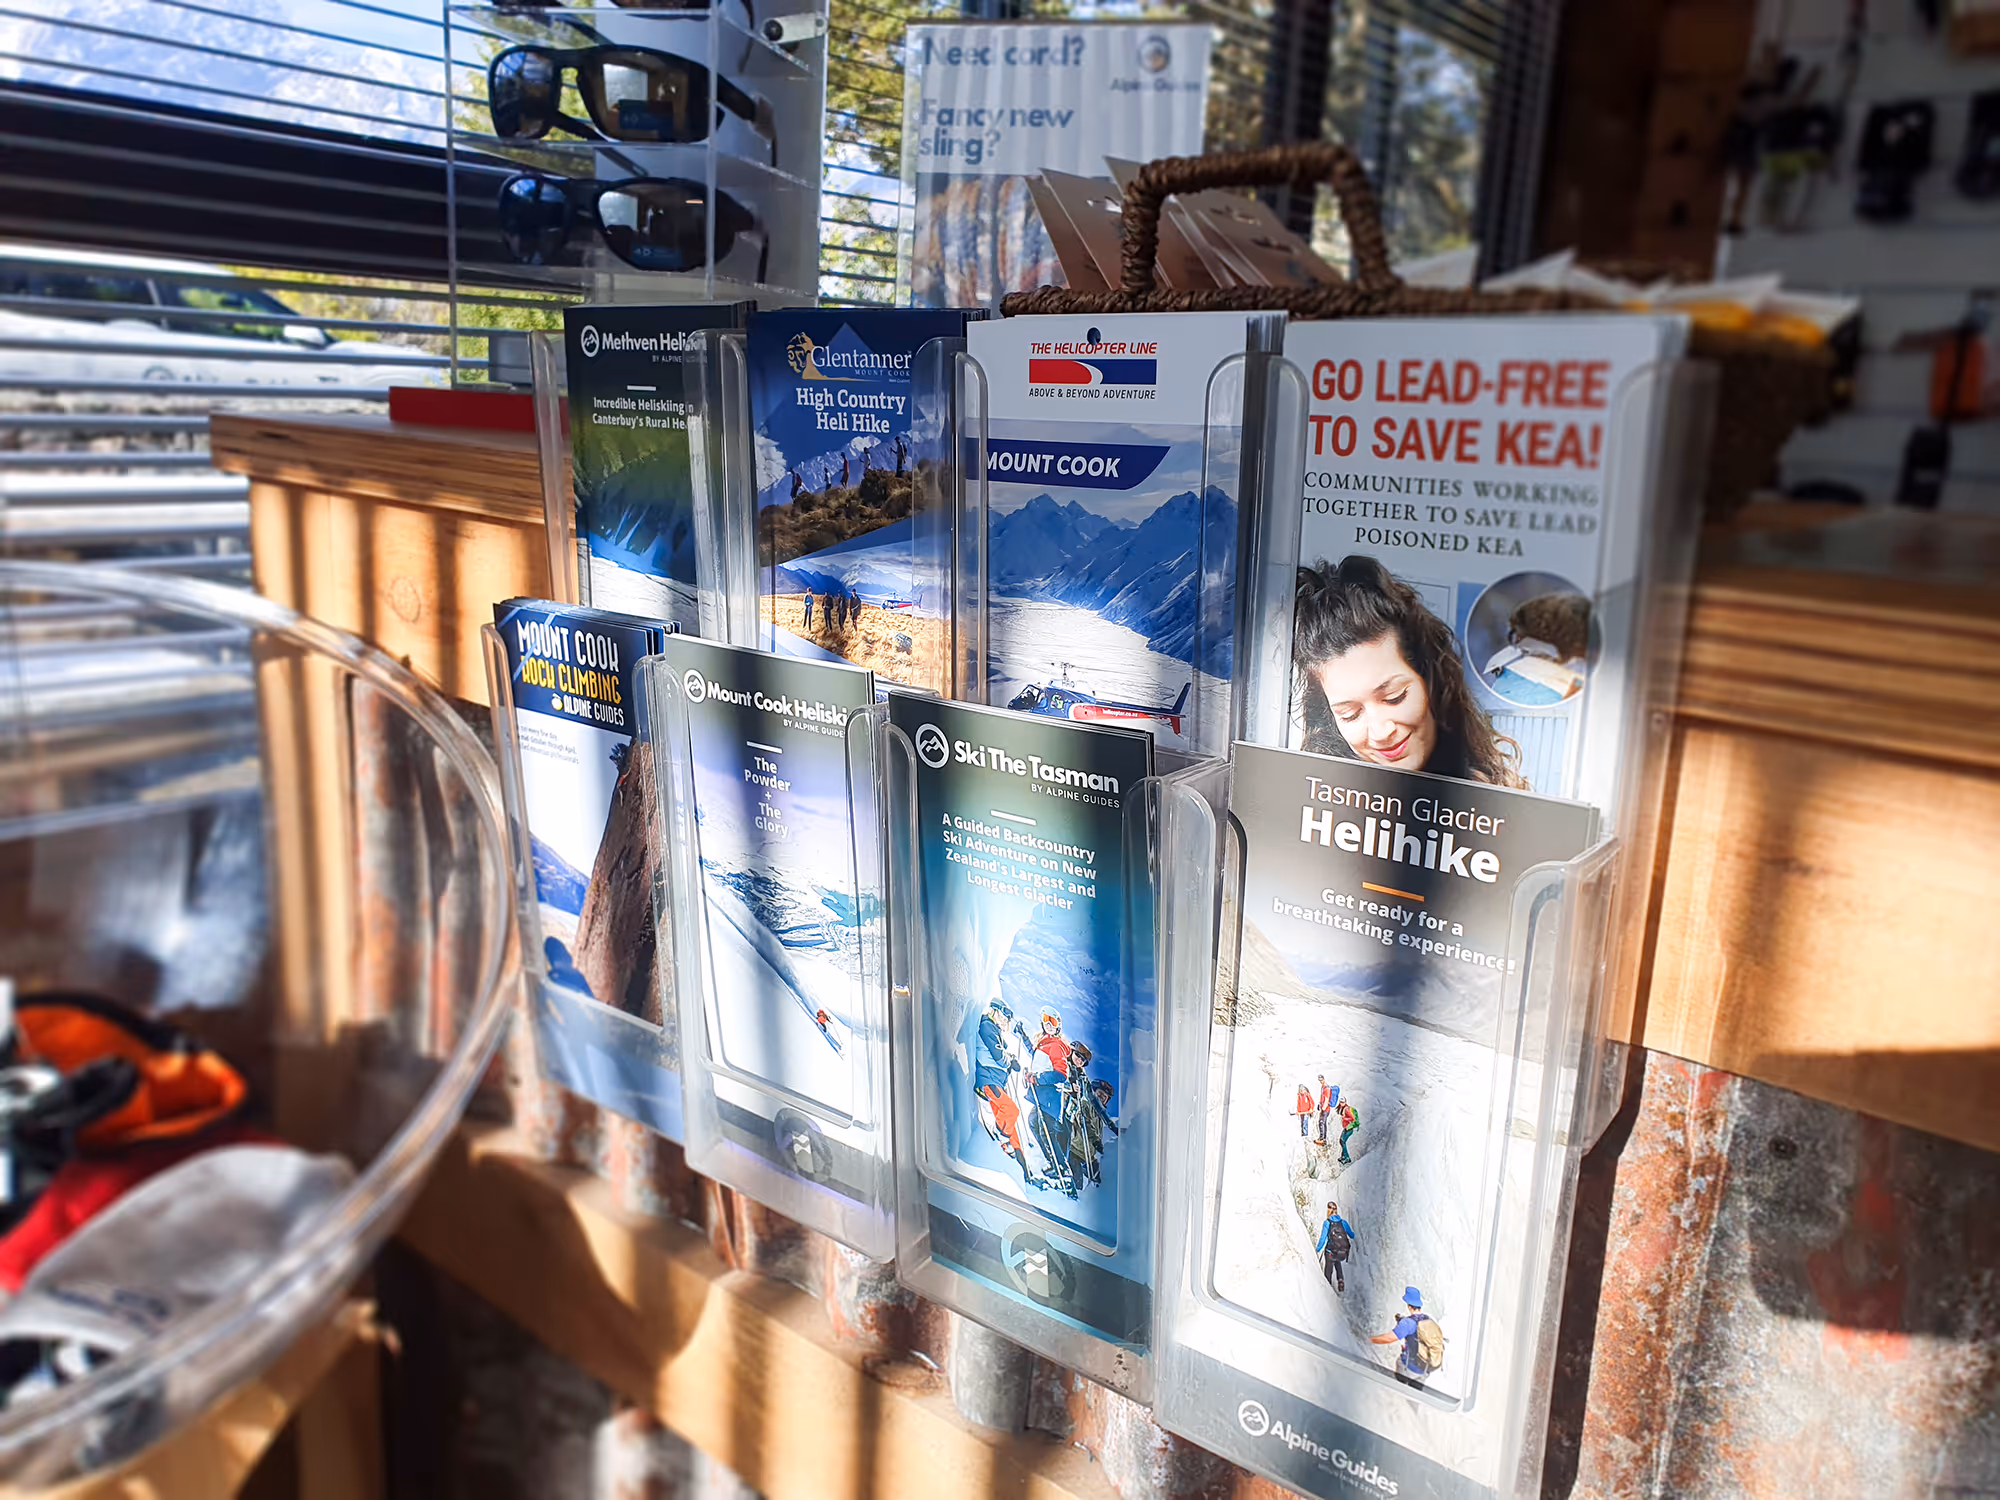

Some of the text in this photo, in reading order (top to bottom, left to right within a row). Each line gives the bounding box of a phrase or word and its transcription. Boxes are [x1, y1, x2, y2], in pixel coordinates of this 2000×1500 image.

[1005, 36, 1085, 66] cord?
[921, 98, 1073, 130] Fancy new
[919, 127, 1000, 165] sling?
[602, 331, 657, 351] Methven
[811, 345, 911, 369] Glentanner
[1031, 342, 1157, 355] THE HELICOPTER LINE
[652, 355, 660, 363] BY
[661, 355, 683, 363] ALPINE
[1029, 388, 1156, 399] ABOVE & BEYOND ADVENTURE
[1312, 358, 1612, 410] GO LEAD-FREE
[594, 397, 636, 410] Incredible
[638, 399, 685, 415] Heliskiing
[796, 388, 906, 415] High Country
[646, 416, 670, 429] Rural
[816, 412, 890, 433] Heli Hike
[1309, 415, 1603, 470] TO SAVE KEA!
[986, 451, 1121, 478] MOUNT COOK
[1304, 471, 1599, 508] COMMUNITIES WORKING
[1303, 497, 1598, 535] TOGETHER TO SAVE LEAD
[1354, 527, 1524, 557] POISONED KEA
[516, 619, 620, 673] MOUNT COOK
[520, 656, 622, 704] ROCK CLIMBING
[563, 694, 625, 726] ALPINE GUIDES
[707, 681, 752, 707] Mount
[753, 691, 794, 716] Cook
[794, 698, 849, 727] Heliski
[783, 719, 793, 727] BY
[794, 722, 819, 734] ALPINE
[744, 769, 791, 792] Powder
[754, 756, 778, 774] The
[954, 740, 1119, 794] Ski The Tasman
[758, 802, 782, 820] The
[1031, 783, 1120, 809] BY ALPINE GUIDES
[1305, 776, 1505, 837] Tasman Glacier
[755, 816, 788, 838] Glory
[942, 813, 1095, 864] A Guided Backcountry
[943, 830, 1096, 880] Ski Adventure on New
[1300, 805, 1501, 884] Helihike
[945, 848, 1096, 898] Zealand's Largest and
[967, 870, 1074, 911] Longest Glacier
[1321, 888, 1464, 937] Get ready for a
[1272, 897, 1516, 976] breathtaking experience!
[1270, 1420, 1330, 1460] Alpine
[1331, 1449, 1399, 1496] Guides
